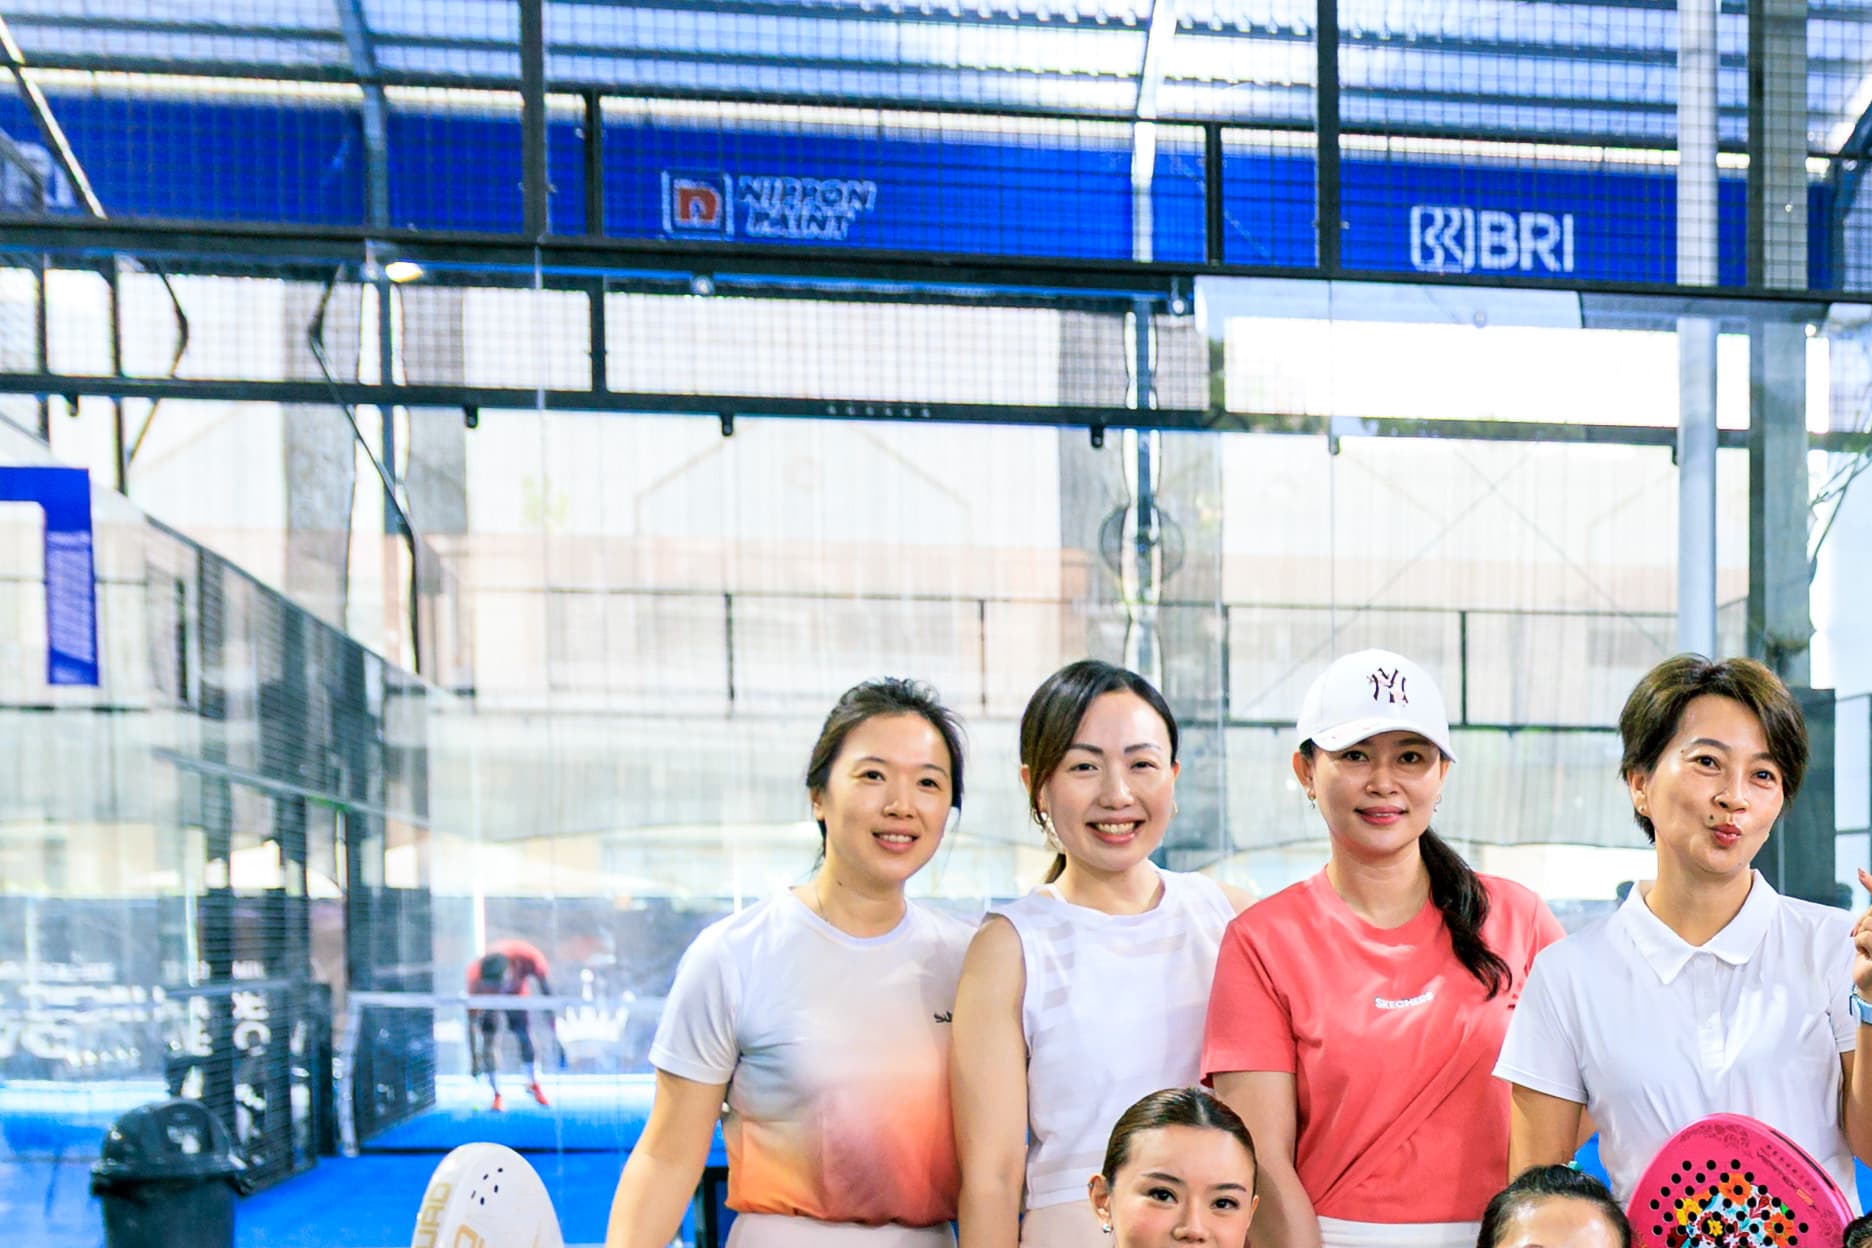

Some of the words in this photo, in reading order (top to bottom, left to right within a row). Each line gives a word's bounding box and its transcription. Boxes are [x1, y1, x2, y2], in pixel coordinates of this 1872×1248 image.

[738, 175, 877, 211] NIPPON
[746, 209, 856, 240] PAINT
[1480, 210, 1574, 272] BRI
